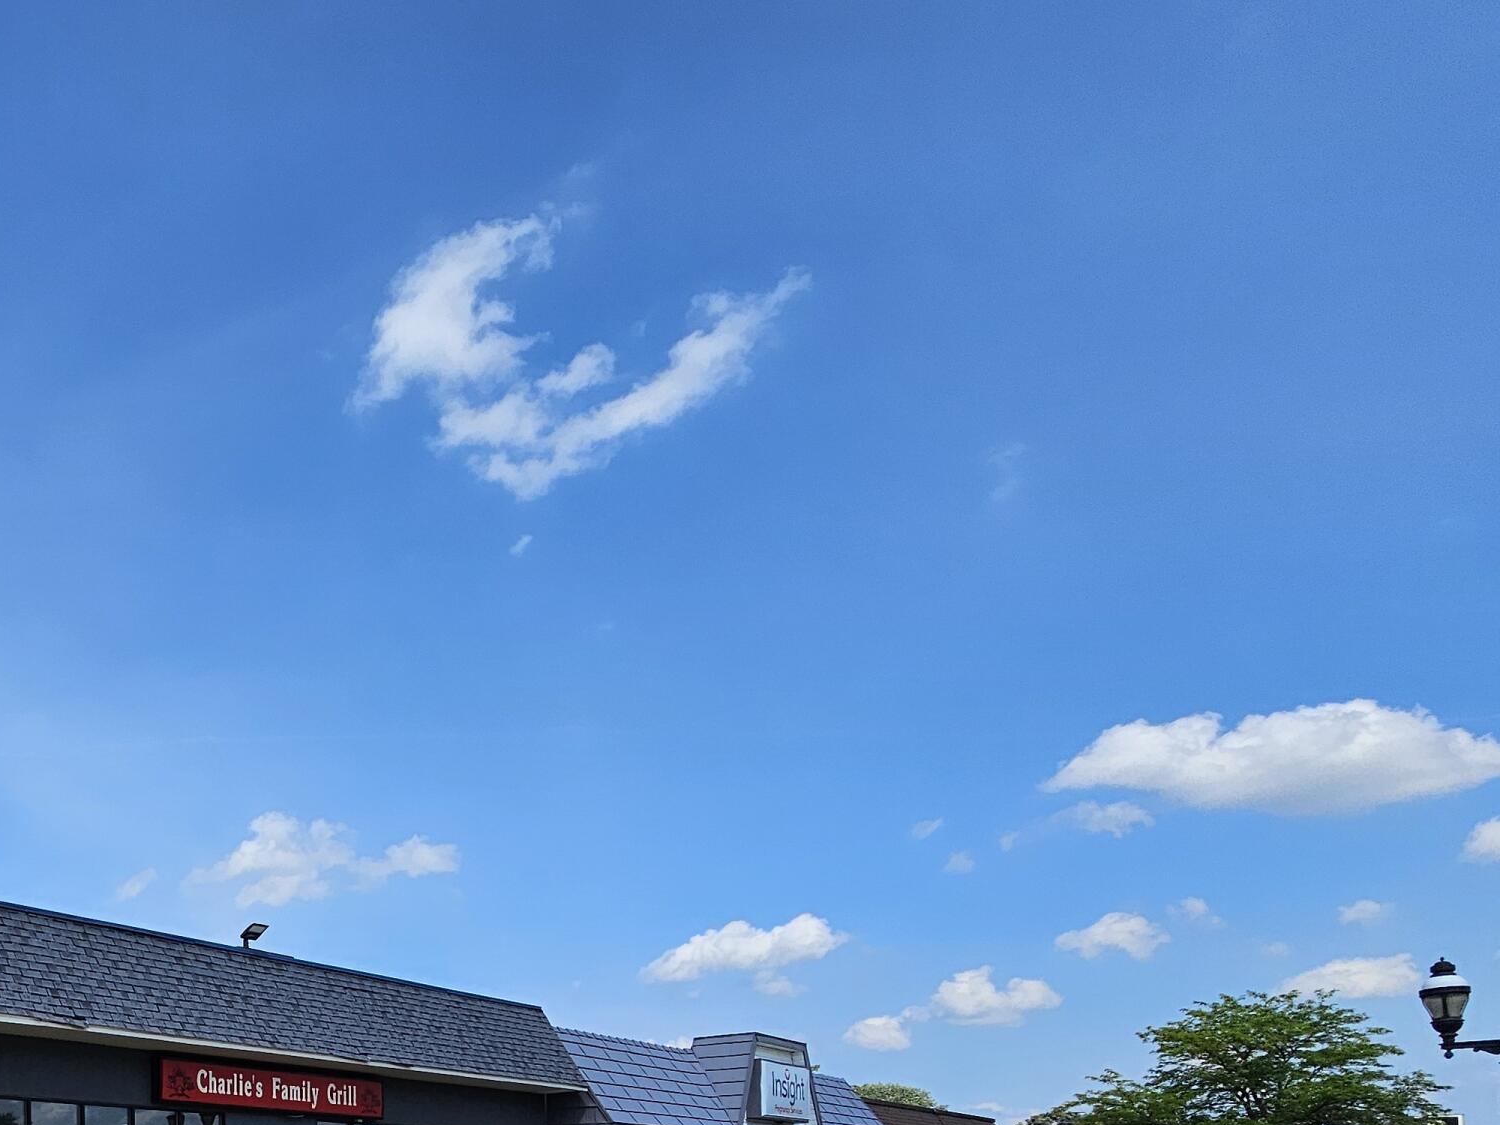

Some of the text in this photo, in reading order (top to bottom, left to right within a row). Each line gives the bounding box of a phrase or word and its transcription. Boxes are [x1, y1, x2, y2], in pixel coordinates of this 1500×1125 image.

[196, 1069, 358, 1109] Charlie's Family Grill
[771, 1069, 805, 1106] Insight
